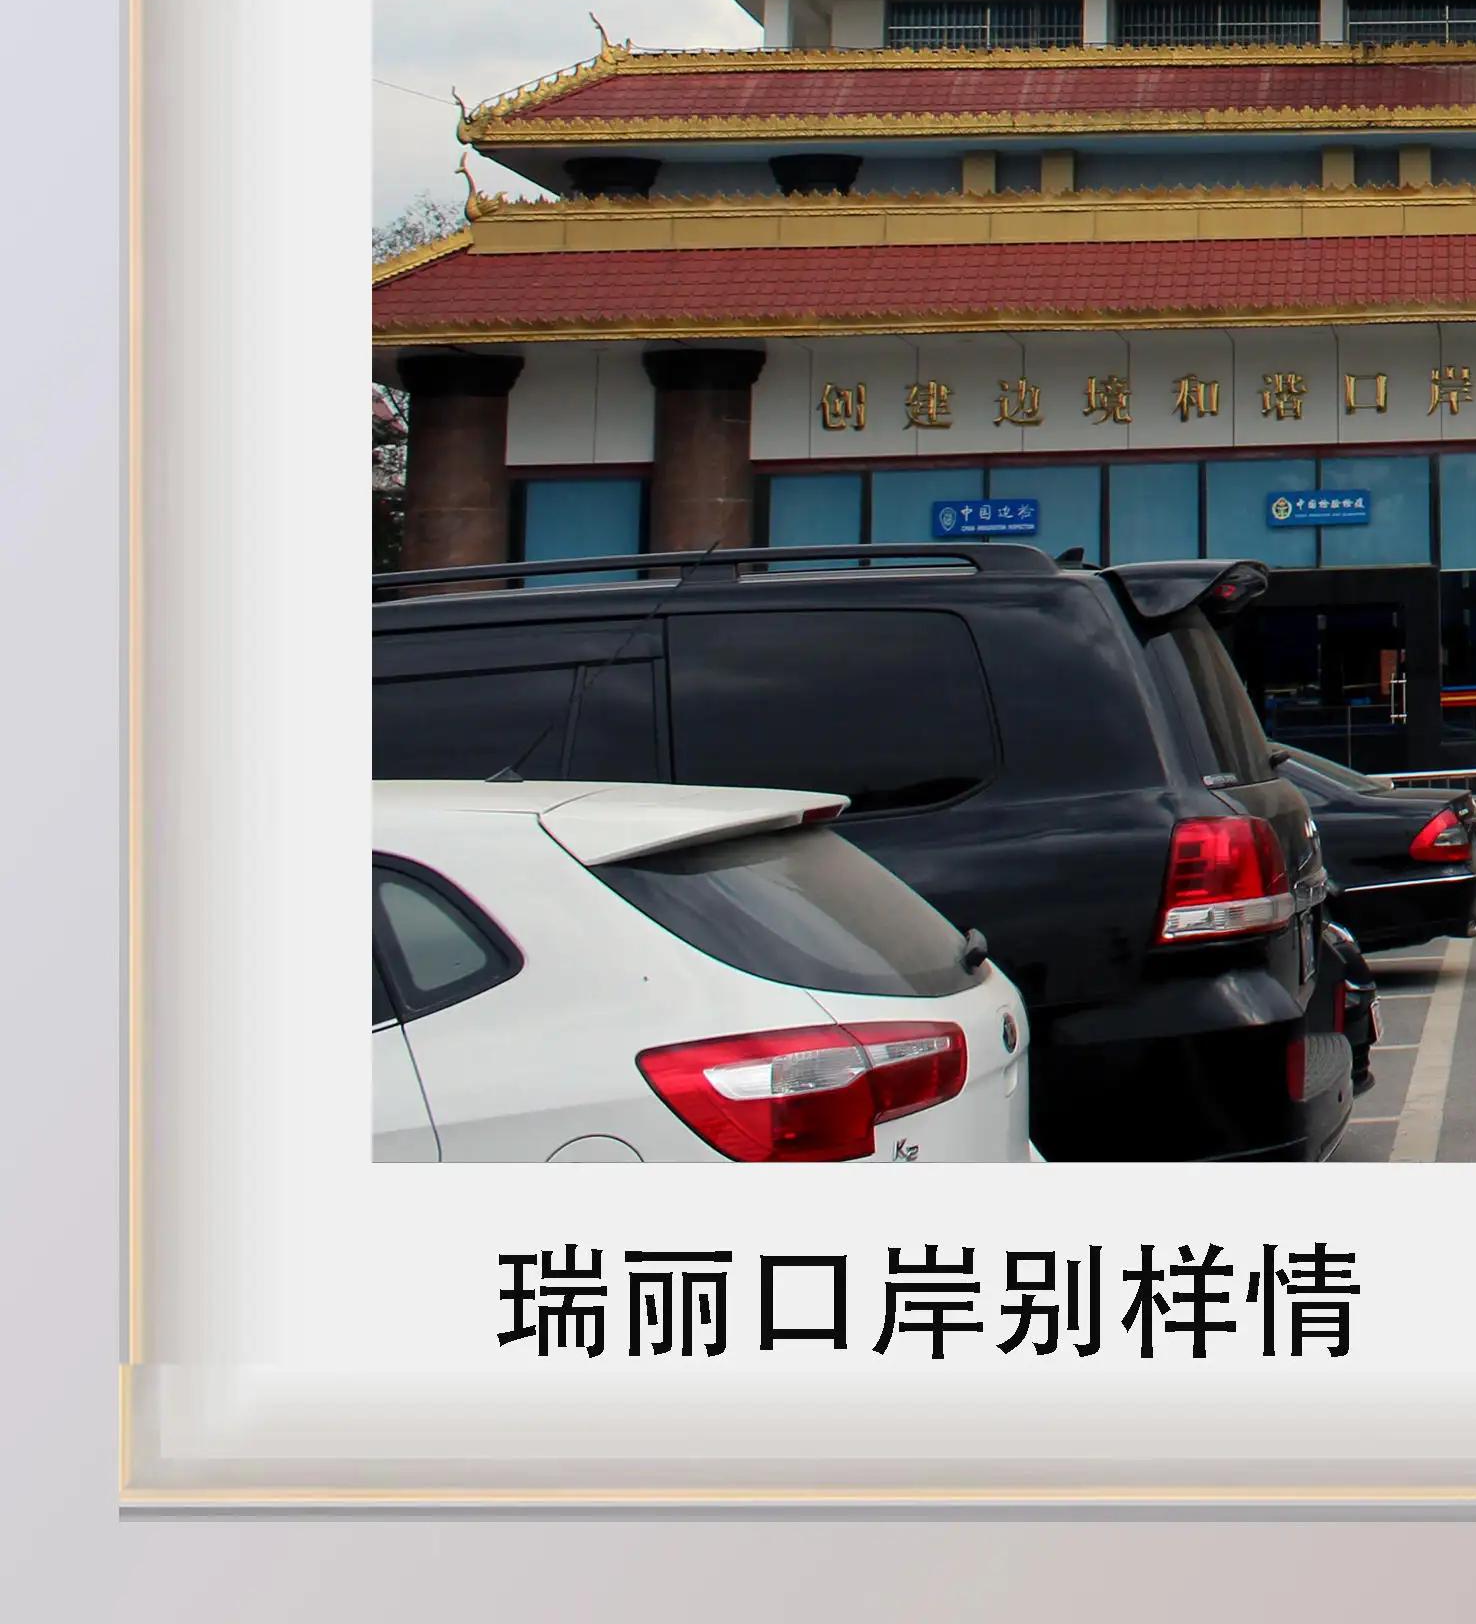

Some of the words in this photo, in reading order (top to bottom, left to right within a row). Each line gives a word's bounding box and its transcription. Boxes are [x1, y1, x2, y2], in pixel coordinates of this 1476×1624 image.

[817, 364, 1474, 432] 创建边境和谐口岸
[892, 1137, 920, 1162] K2
